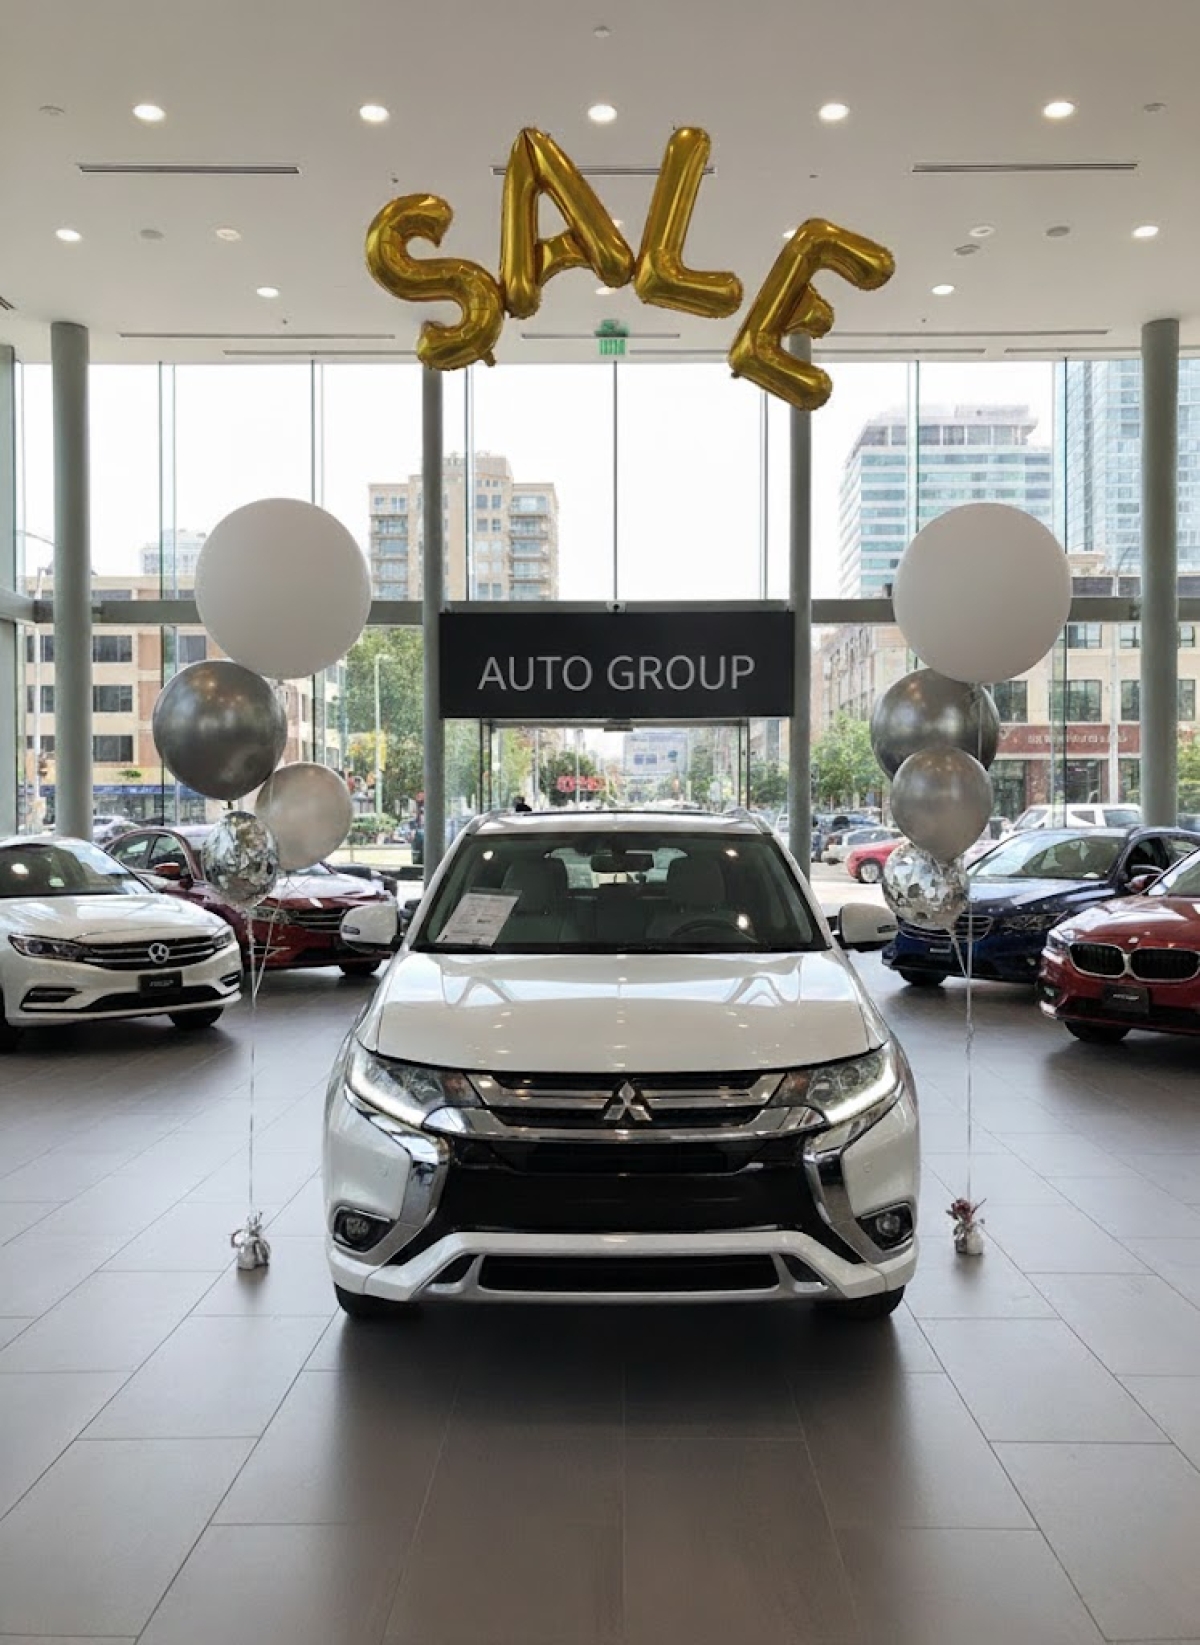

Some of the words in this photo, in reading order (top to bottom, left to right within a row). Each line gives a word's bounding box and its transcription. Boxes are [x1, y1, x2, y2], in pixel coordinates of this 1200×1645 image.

[365, 126, 896, 411] SALE
[477, 655, 593, 691] AUTO
[606, 655, 756, 691] GROUP
